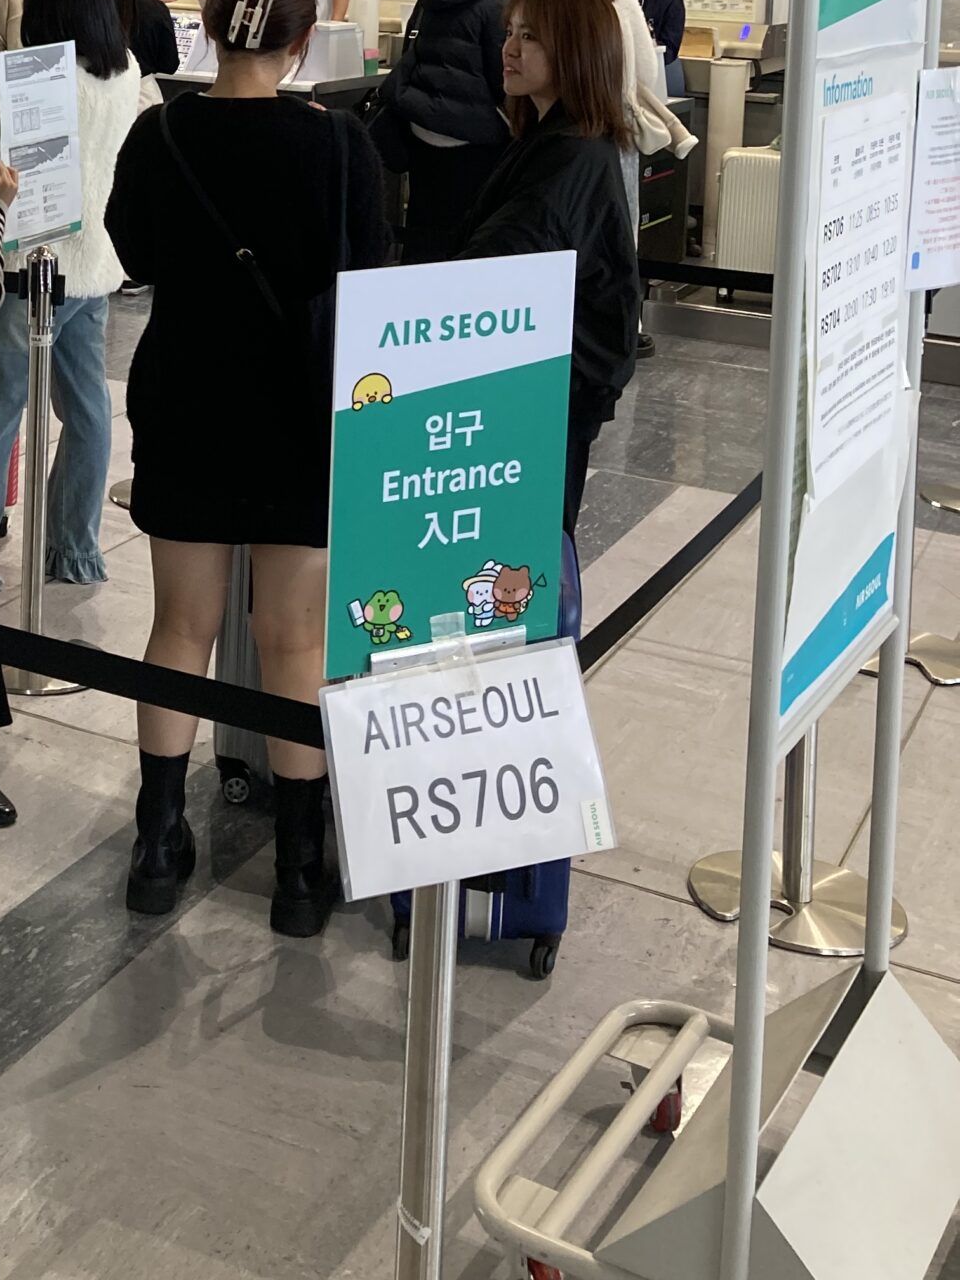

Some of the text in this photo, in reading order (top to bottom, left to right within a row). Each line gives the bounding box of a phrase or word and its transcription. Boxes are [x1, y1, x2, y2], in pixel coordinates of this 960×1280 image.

[823, 70, 873, 107] Information
[823, 215, 844, 244] RS706
[821, 261, 841, 291] RS702
[378, 307, 536, 348] AIR SEOUL
[820, 307, 840, 336] RS704
[425, 409, 485, 452] 입구
[382, 459, 522, 503] Entrance
[417, 506, 482, 550] 入口
[864, 573, 881, 600] SEOUL
[386, 757, 559, 845] RS706
[589, 801, 601, 830] SEOUL
